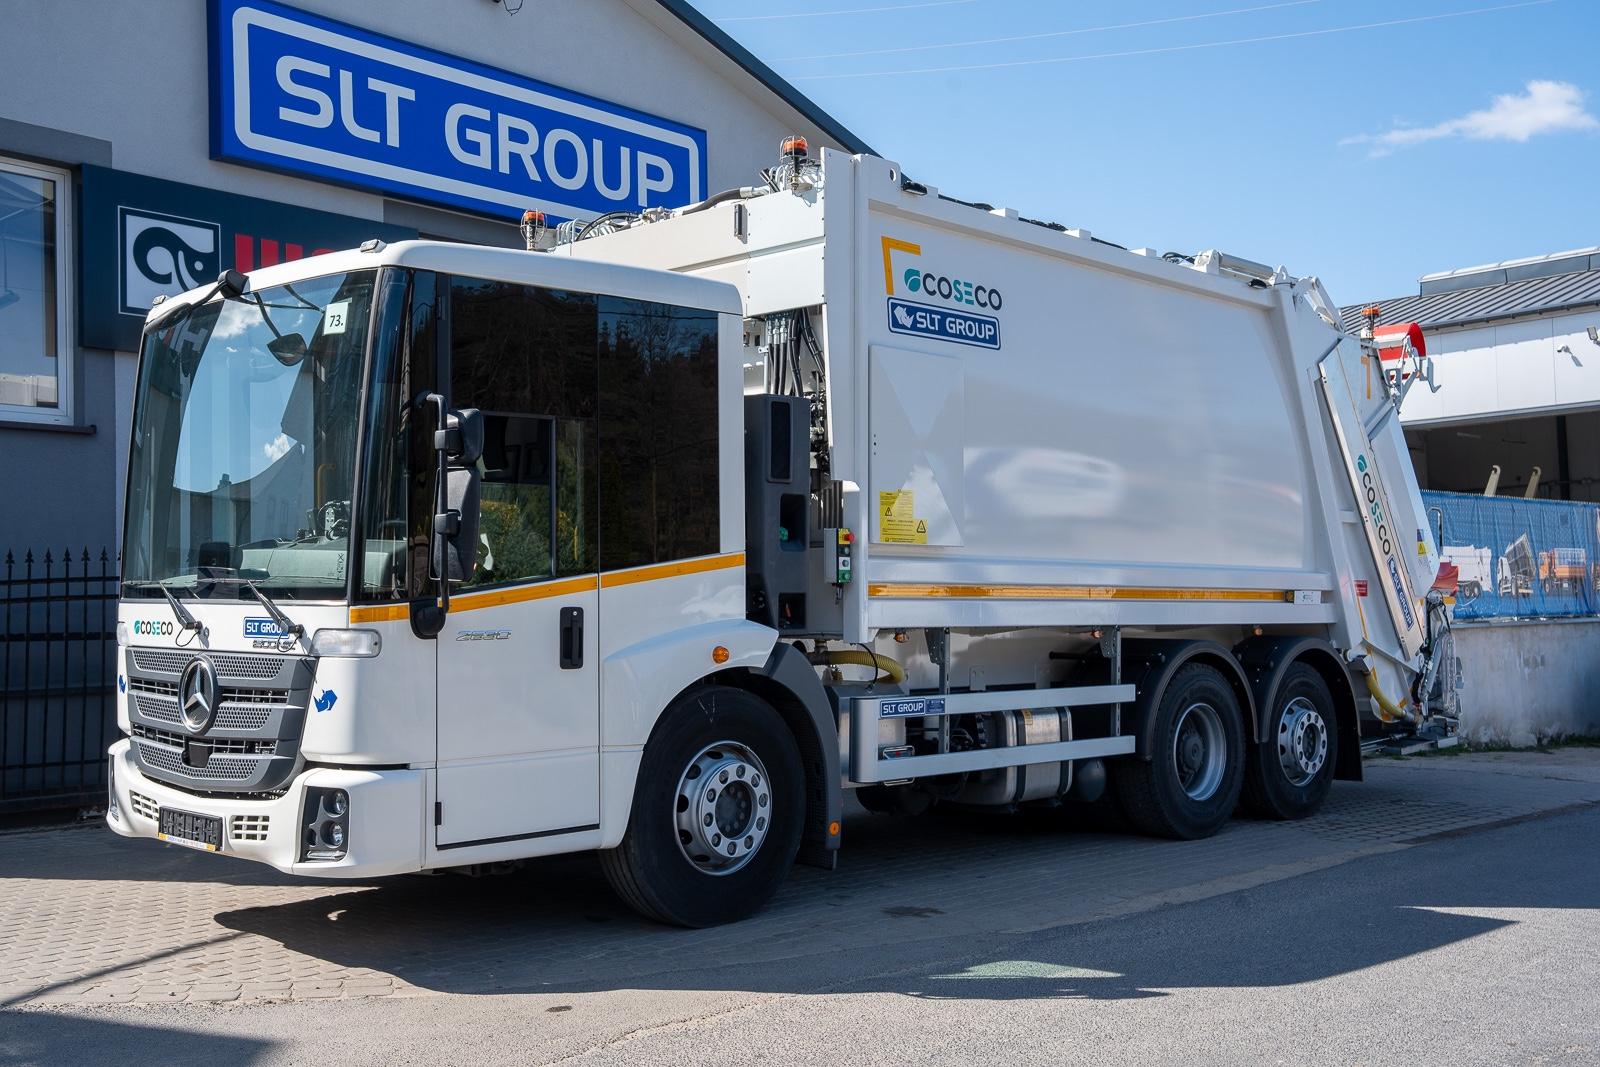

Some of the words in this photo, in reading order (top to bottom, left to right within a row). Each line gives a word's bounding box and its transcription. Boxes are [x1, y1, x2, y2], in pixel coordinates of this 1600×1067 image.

[275, 55, 416, 148] SLT
[444, 102, 674, 207] GROUP
[923, 273, 1002, 310] COSECO
[329, 314, 344, 328] 73.
[916, 312, 940, 330] SLT
[946, 318, 994, 339] GROUP
[1363, 473, 1391, 555] COSECO
[1393, 573, 1402, 590] SLT
[1399, 591, 1412, 624] GROUP
[140, 620, 174, 636] COSECO
[246, 622, 259, 632] SLT
[261, 623, 282, 633] GROU
[883, 704, 895, 713] SLT
[898, 703, 923, 713] GROUP
